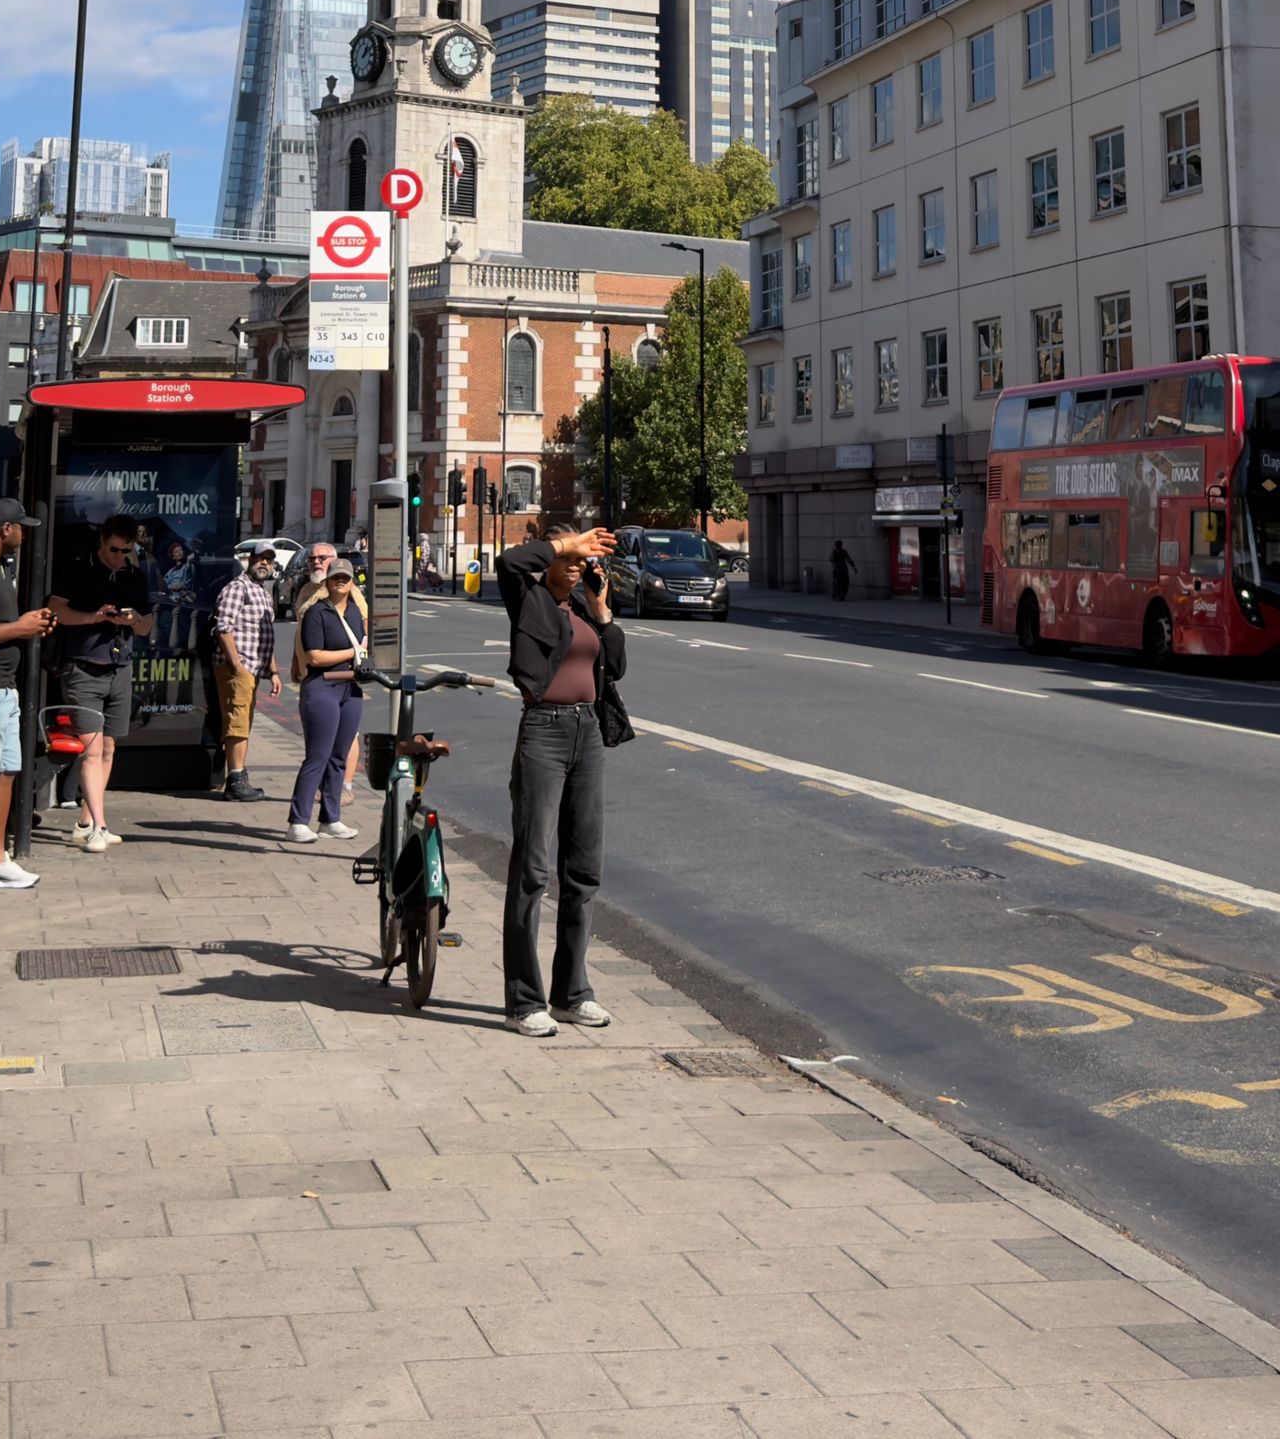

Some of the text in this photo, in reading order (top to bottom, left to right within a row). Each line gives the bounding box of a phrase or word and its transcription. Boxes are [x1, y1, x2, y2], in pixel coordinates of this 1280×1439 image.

[390, 174, 417, 205] D
[330, 238, 369, 246] BUS STOP
[334, 284, 365, 293] Borough
[331, 291, 358, 300] Station
[316, 332, 385, 341] 35 343 C10
[309, 354, 335, 364] N343
[151, 383, 191, 393] Borough
[147, 393, 182, 403] Station
[1055, 462, 1117, 495] THE DOG STARS
[1171, 466, 1200, 483] IMAX
[72, 469, 160, 492] old MONEY.
[157, 493, 212, 515] TRICKS.
[130, 658, 190, 682] LEMEN
[139, 704, 194, 713] NOW PLAYING
